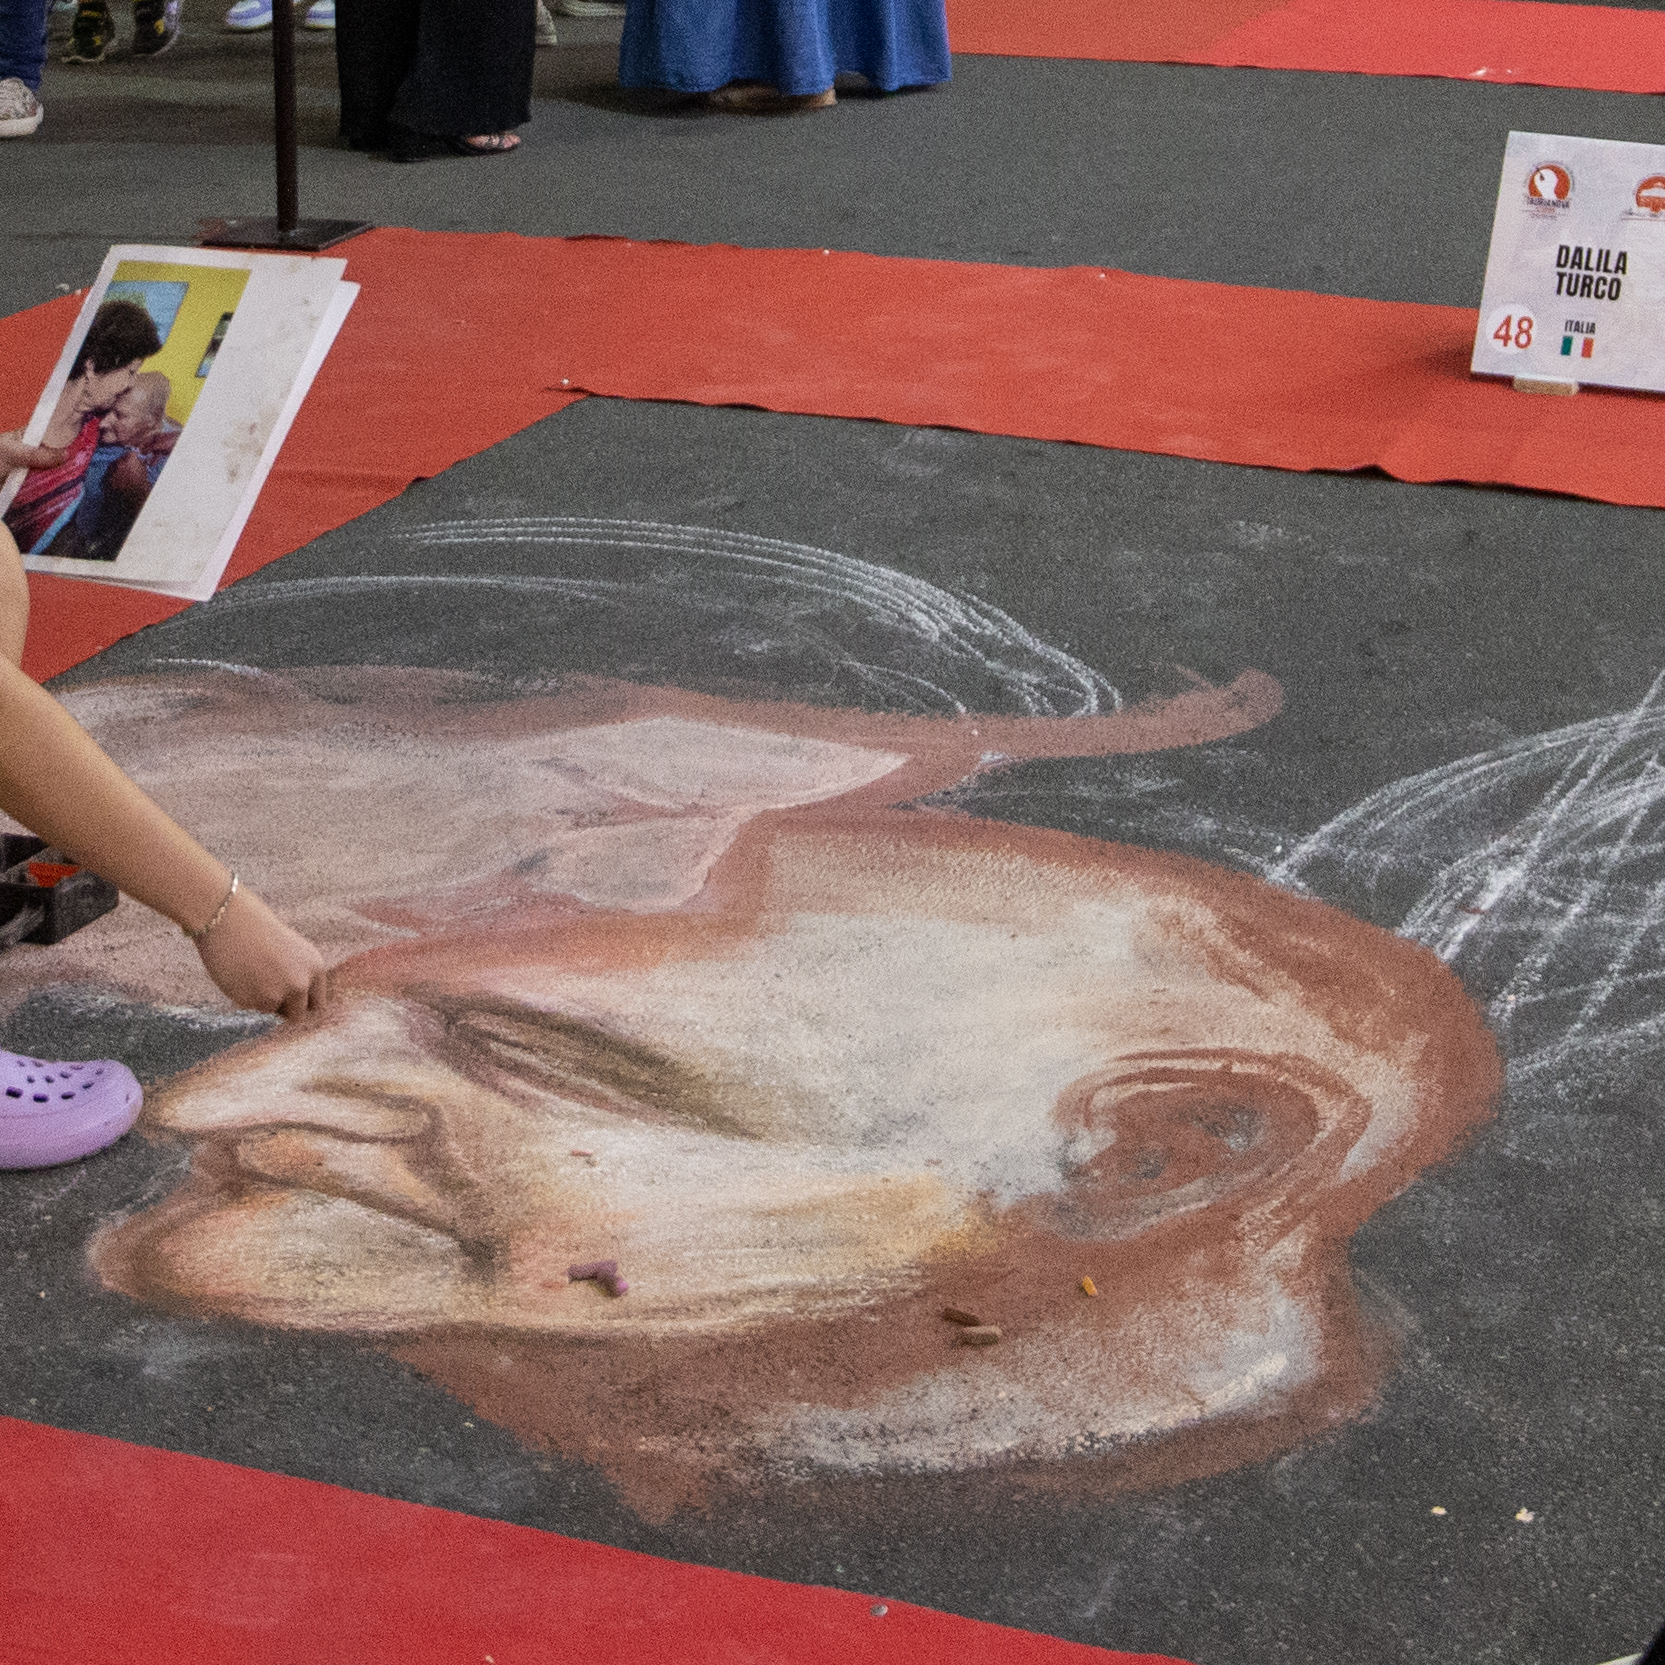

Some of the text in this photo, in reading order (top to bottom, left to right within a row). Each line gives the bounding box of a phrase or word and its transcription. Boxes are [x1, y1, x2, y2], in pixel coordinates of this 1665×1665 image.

[1556, 244, 1628, 277] DALILA
[1555, 272, 1622, 302] TURCO
[1492, 313, 1534, 351] 48
[1564, 319, 1596, 335] ITALIA
